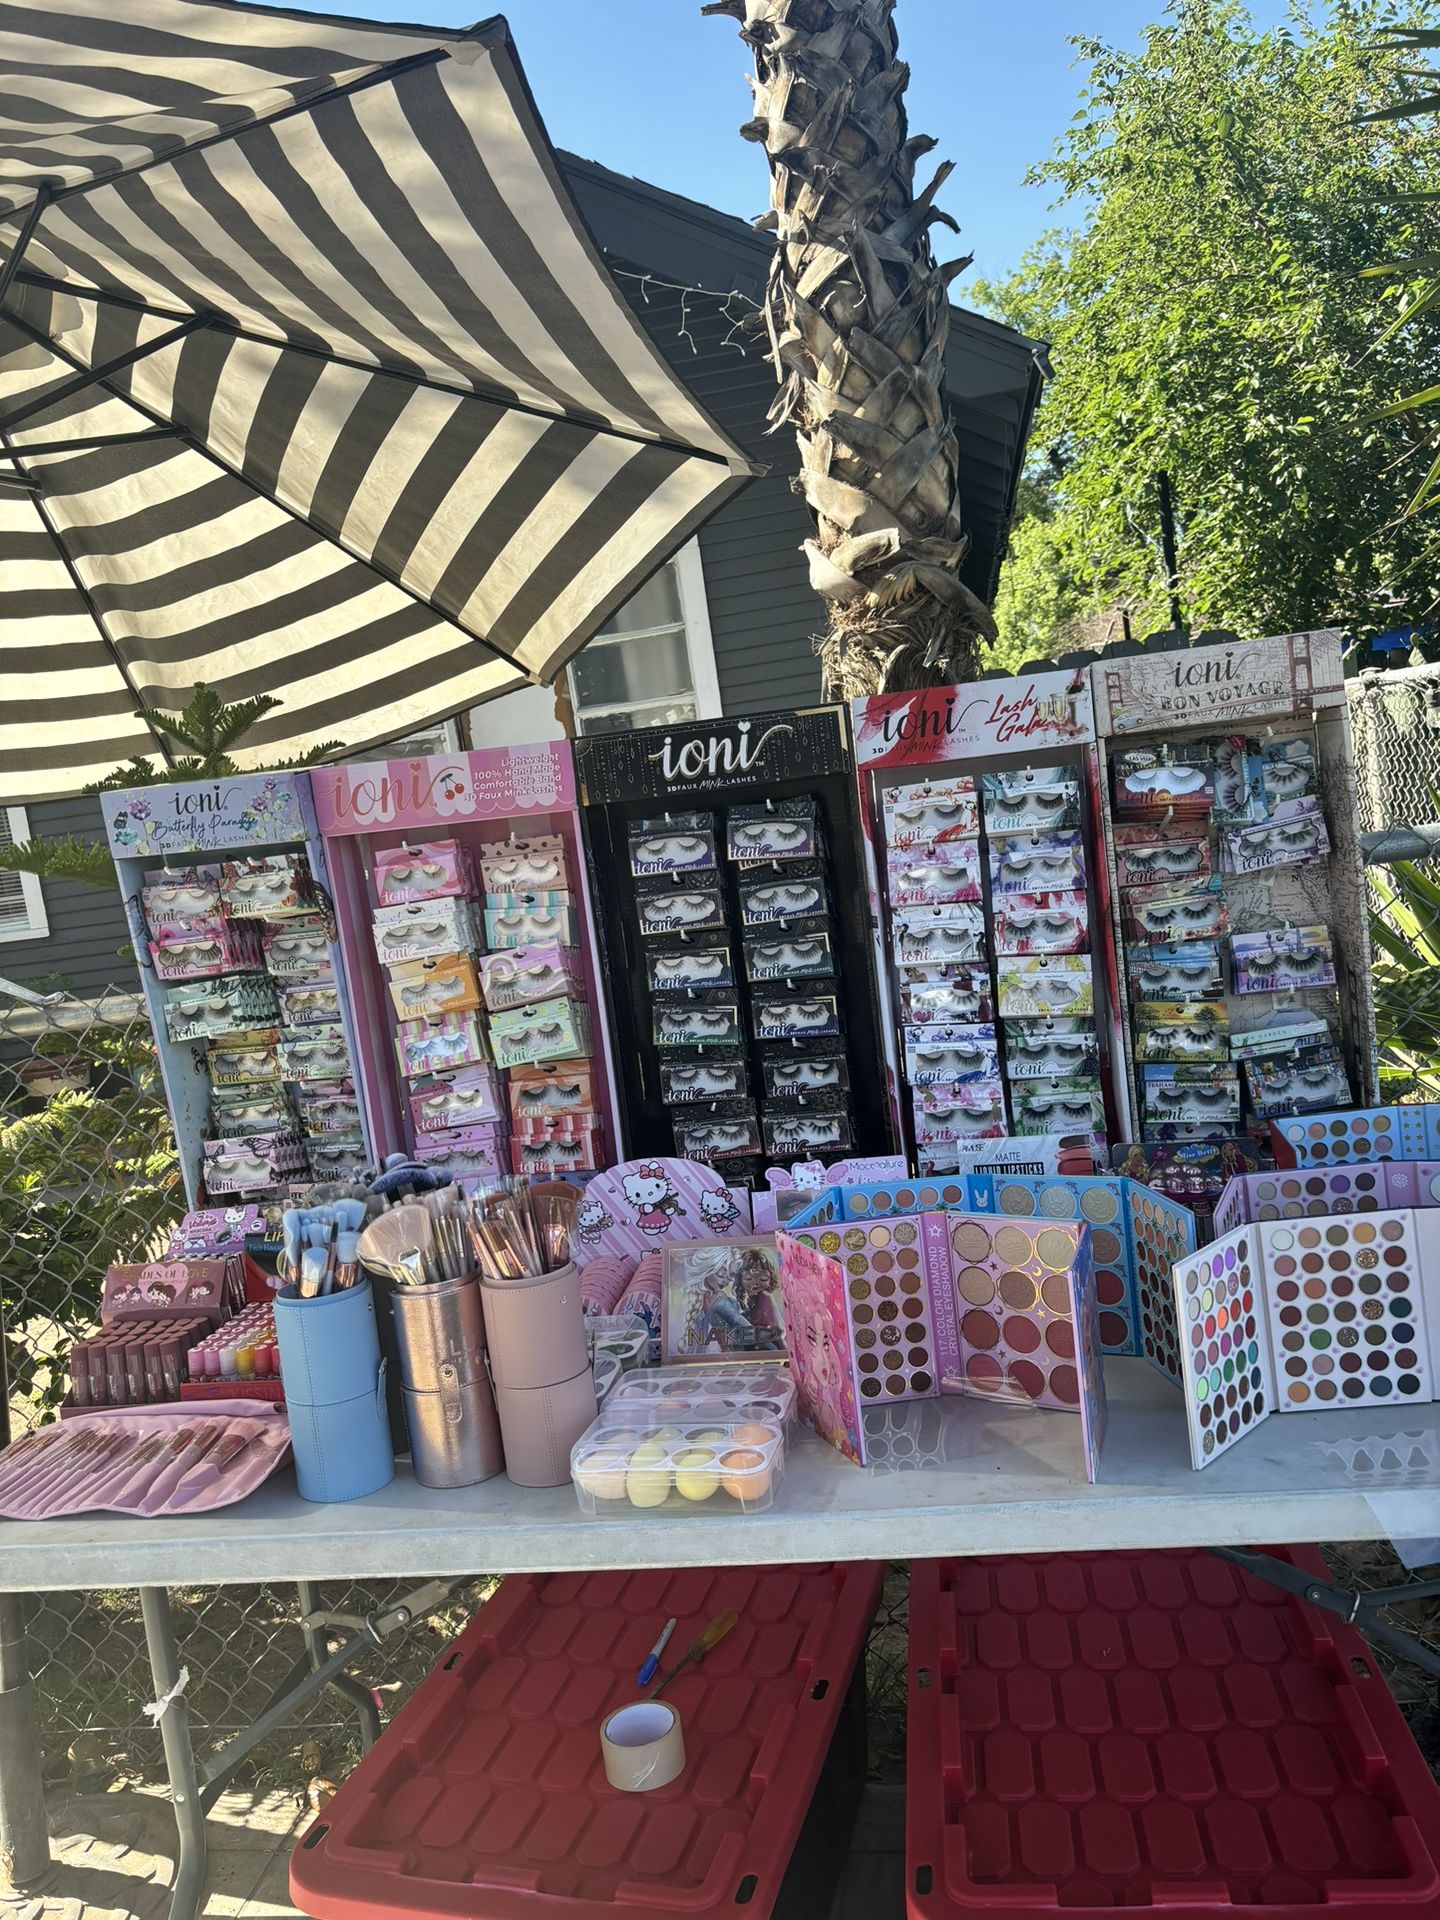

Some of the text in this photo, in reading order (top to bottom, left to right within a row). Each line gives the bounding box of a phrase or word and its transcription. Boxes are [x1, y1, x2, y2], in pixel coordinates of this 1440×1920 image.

[1166, 651, 1261, 688] ioni
[1159, 680, 1285, 711] BON VOYAGE
[984, 684, 1038, 725] Lash
[1216, 704, 1255, 719] MINK
[872, 698, 990, 743] ioni
[944, 734, 981, 746] LASHES
[648, 721, 794, 782] ioni
[501, 753, 560, 767] Lightweight
[474, 763, 561, 781] 100% Hand Made
[474, 773, 562, 791] Comfortable Band
[699, 779, 728, 790] MINK
[726, 776, 757, 785] LASHES
[320, 762, 464, 818] ioni
[479, 790, 503, 800] Faux
[504, 786, 529, 797] Mink
[530, 784, 563, 795] Lashes
[168, 785, 242, 816] ioni
[152, 813, 259, 841] Butterfly Paradise
[992, 813, 1031, 829] ioni
[894, 827, 930, 842] ioni
[731, 844, 771, 858] ioni
[635, 859, 671, 874] ioni
[1242, 851, 1274, 870] ioni
[1125, 867, 1158, 884] ioni
[491, 880, 529, 894] ioni
[383, 887, 417, 903] ioni
[152, 909, 184, 923] ioni
[747, 907, 783, 923] ioni
[645, 917, 680, 933] ioni
[493, 934, 528, 948] ioni
[383, 943, 419, 961] ioni
[162, 962, 194, 977] ioni
[272, 958, 306, 972] ioni
[752, 964, 789, 980] ioni
[653, 974, 689, 989] ioni
[1247, 974, 1278, 990] ioni
[491, 988, 524, 1006] ioni
[288, 1008, 317, 1022] ioni
[401, 1001, 432, 1017] ioni
[174, 1023, 209, 1037] ioni
[659, 1030, 695, 1044] ioni
[760, 1022, 796, 1037] ioni
[501, 1047, 530, 1065] ioni
[285, 1065, 317, 1079] ioni
[914, 1068, 948, 1083] ioni
[1015, 1061, 1050, 1076] ioni
[217, 1070, 251, 1083] ioni
[668, 1087, 704, 1102] ioni
[772, 1081, 808, 1097] ioni
[517, 1103, 549, 1118] ioni
[1152, 1107, 1190, 1121] ioni
[418, 1112, 450, 1131] ioni
[222, 1125, 256, 1137] ioni
[683, 1146, 718, 1161] ioni
[771, 1139, 806, 1154] ioni
[962, 1143, 984, 1152] AMUSE
[519, 1157, 549, 1172] ioni
[995, 1152, 1021, 1162] MATTE
[1002, 1163, 1044, 1175] LIPSTICKS
[210, 1178, 242, 1192] ioni
[928, 1246, 950, 1356] 117 COLOR DIAMOND
[938, 1246, 958, 1357] CRYSTAL EYESHADOW
[687, 1325, 781, 1347] NAKED
